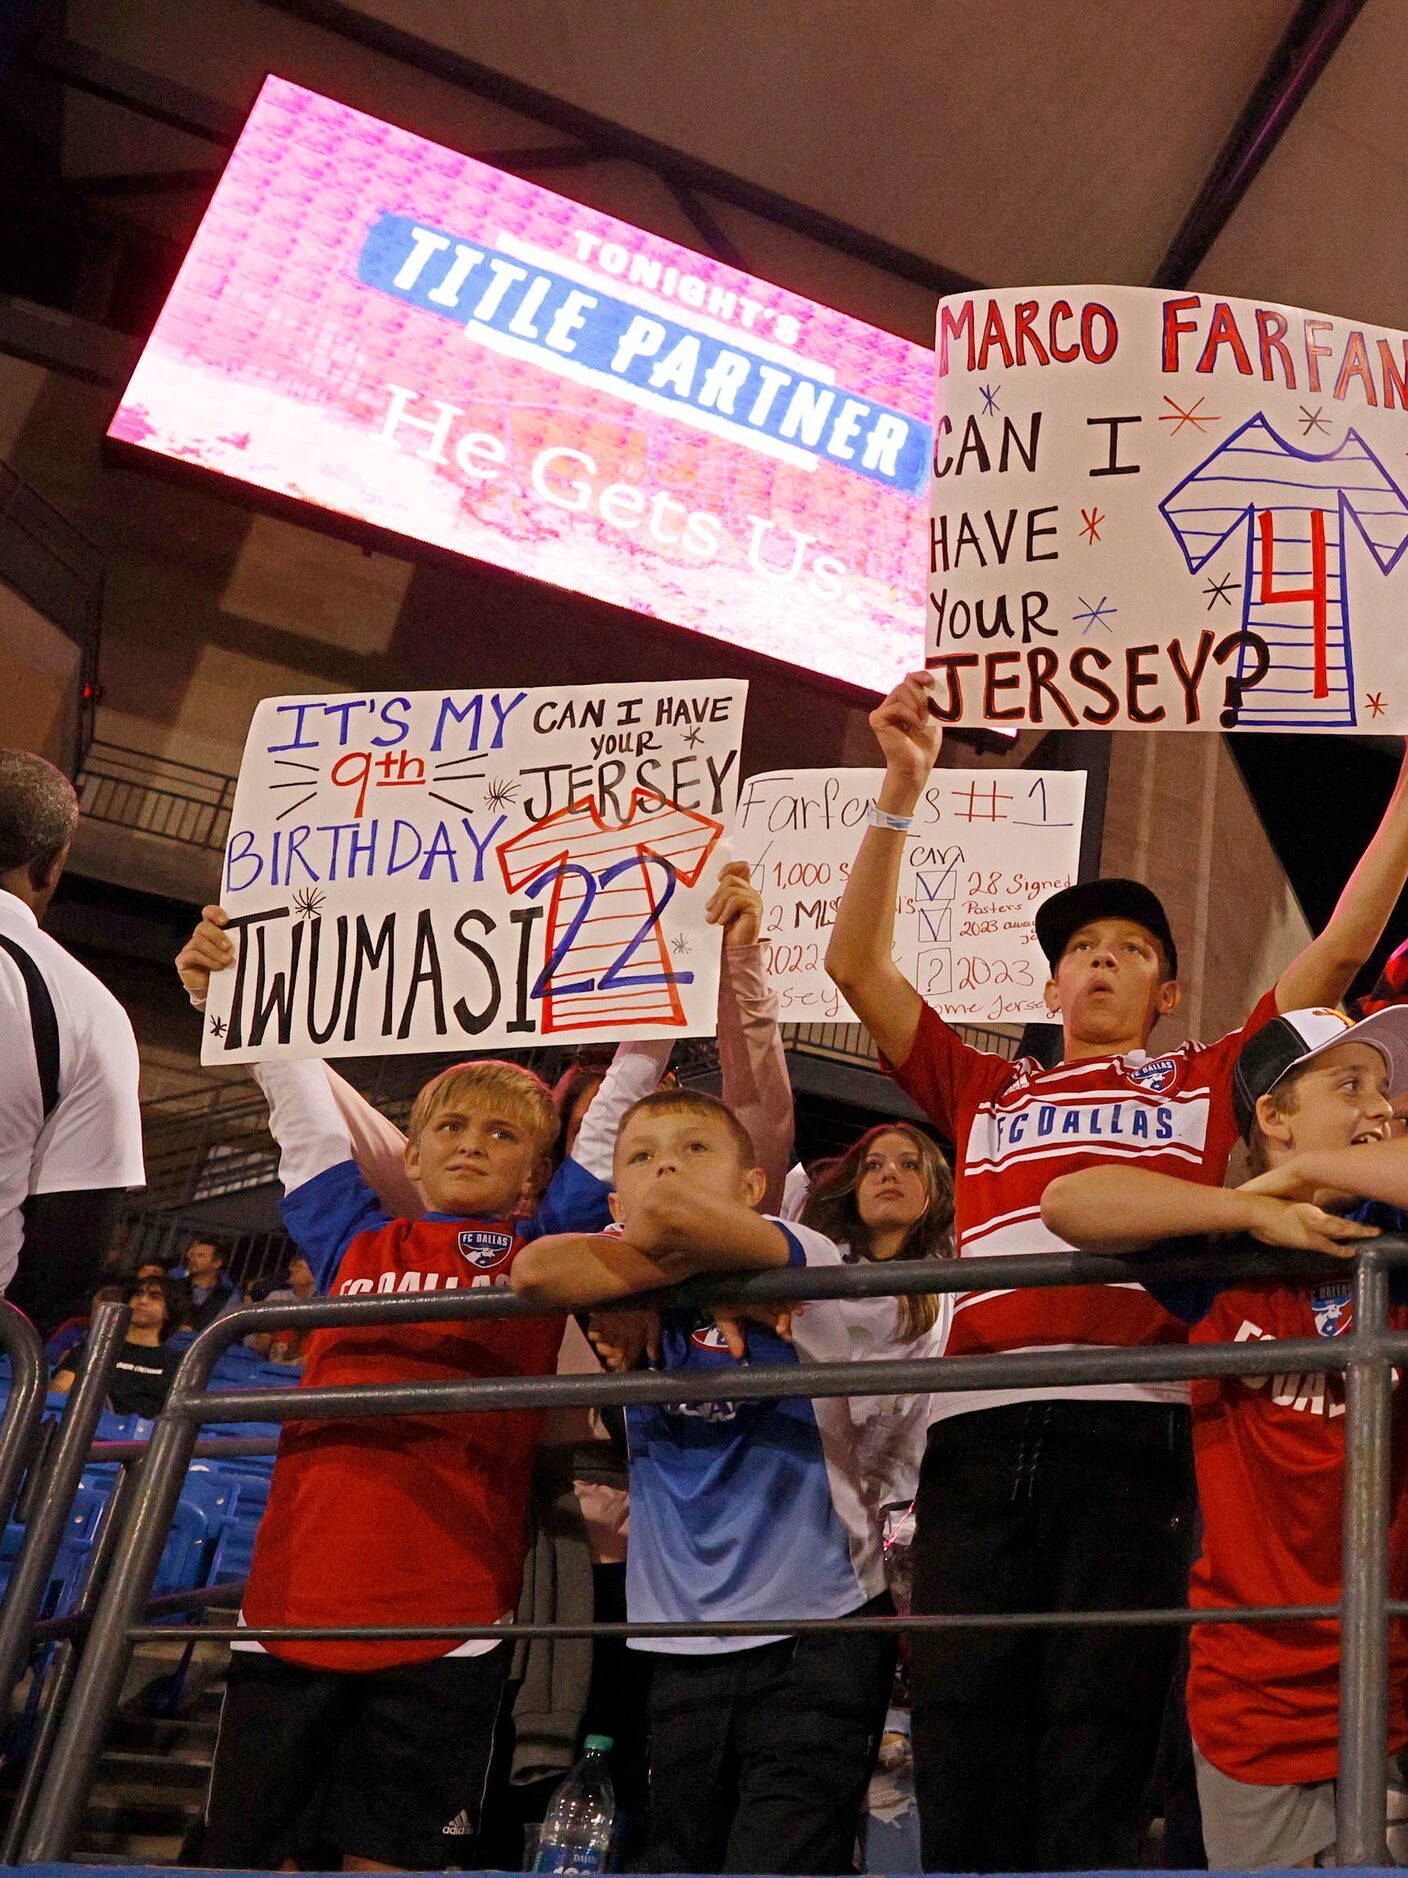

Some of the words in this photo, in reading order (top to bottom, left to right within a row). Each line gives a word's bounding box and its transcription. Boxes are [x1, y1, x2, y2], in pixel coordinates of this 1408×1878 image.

[572, 229, 801, 345] TONIGHT'S
[393, 226, 600, 355] TITLE
[615, 314, 910, 478] PARTNER
[938, 299, 1118, 377] MARCO
[379, 382, 507, 480] He
[530, 444, 722, 559] Gets
[934, 412, 1042, 478] CAN
[1086, 415, 1142, 476] I
[929, 505, 1059, 573] HAVE
[929, 588, 1059, 647] YOUR
[1257, 509, 1329, 699] 4
[925, 630, 1271, 729] JERSEY?
[267, 697, 411, 753] IT'S
[430, 692, 528, 752] MY
[533, 698, 604, 735] CAN
[617, 698, 643, 726] I
[656, 696, 733, 727] HAVE
[590, 730, 662, 760] YOUR
[331, 749, 427, 818] 9th
[518, 750, 738, 824] JERSEY
[226, 815, 507, 893] BIRTHDAY
[773, 862, 831, 889] 1,000
[962, 901, 1023, 915] Posters
[968, 872, 1003, 896] 28
[1007, 874, 1072, 901] Signed
[524, 856, 694, 1000] 22
[767, 905, 784, 932] 2
[960, 921, 999, 937] 2023
[223, 906, 544, 1050] TWUMASI
[957, 956, 1034, 990] 2023
[1142, 1061, 1173, 1073] DALLAS
[1038, 1104, 1173, 1140] DALLAS
[462, 1233, 474, 1243] FC
[476, 1233, 508, 1247] DALLAS
